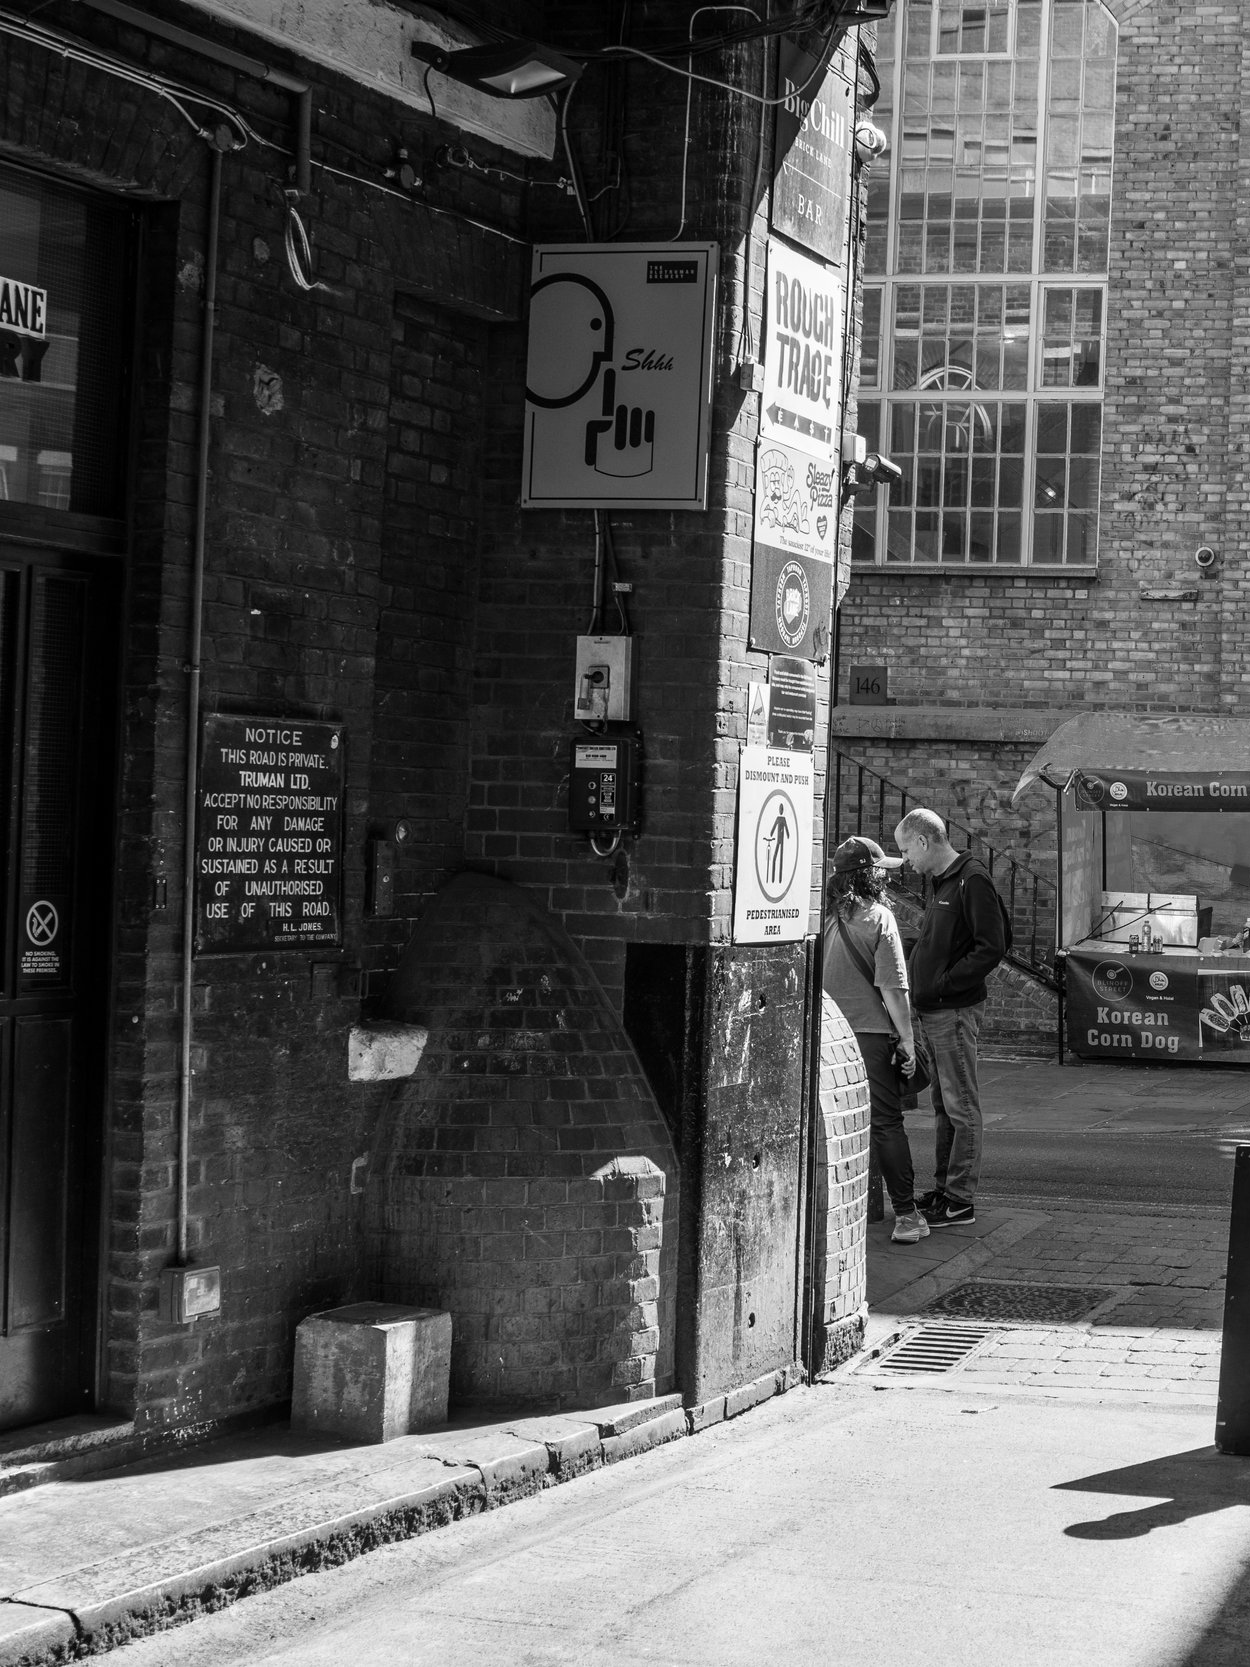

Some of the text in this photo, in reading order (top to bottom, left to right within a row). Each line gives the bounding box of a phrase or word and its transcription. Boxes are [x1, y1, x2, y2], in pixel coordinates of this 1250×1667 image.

[784, 77, 844, 149] Big Chill
[795, 136, 832, 169] BRICK LANE
[797, 193, 822, 226] BAR
[775, 270, 834, 351] ROUGH
[621, 348, 674, 372] Shhh
[775, 331, 833, 410] TRADE
[806, 462, 835, 493] Sleazy
[809, 486, 833, 512] Pizza
[855, 677, 881, 695] 146
[245, 728, 303, 746] NOTICE
[221, 748, 329, 769] THIS ROAD IS PRIVATE.
[767, 756, 790, 768] PLEASE
[239, 770, 312, 791] TRUMAN LTD.
[603, 774, 613, 782] 24
[745, 770, 809, 786] DISMOUNT AND PUSH
[1146, 781, 1205, 797] Korean
[1209, 782, 1248, 797] Corn
[204, 793, 338, 811] ACCEPT NO RESPONSIBILITY
[217, 815, 325, 832] FOR ANY DAMAGE
[208, 837, 332, 853] OR INJURY CAUSED OR
[201, 859, 335, 874] SUSTAINED AS A RESULT
[215, 881, 324, 896] OF UNAUTHORISED
[206, 901, 332, 919] USE OF THIS ROAD.
[746, 908, 800, 921] PEDESTRIANISED
[298, 922, 324, 932] JONES.
[763, 925, 781, 936] AREA
[315, 933, 337, 941] COMPANY
[1096, 1006, 1169, 1026] Korean
[1087, 1028, 1180, 1053] Corn Dog
